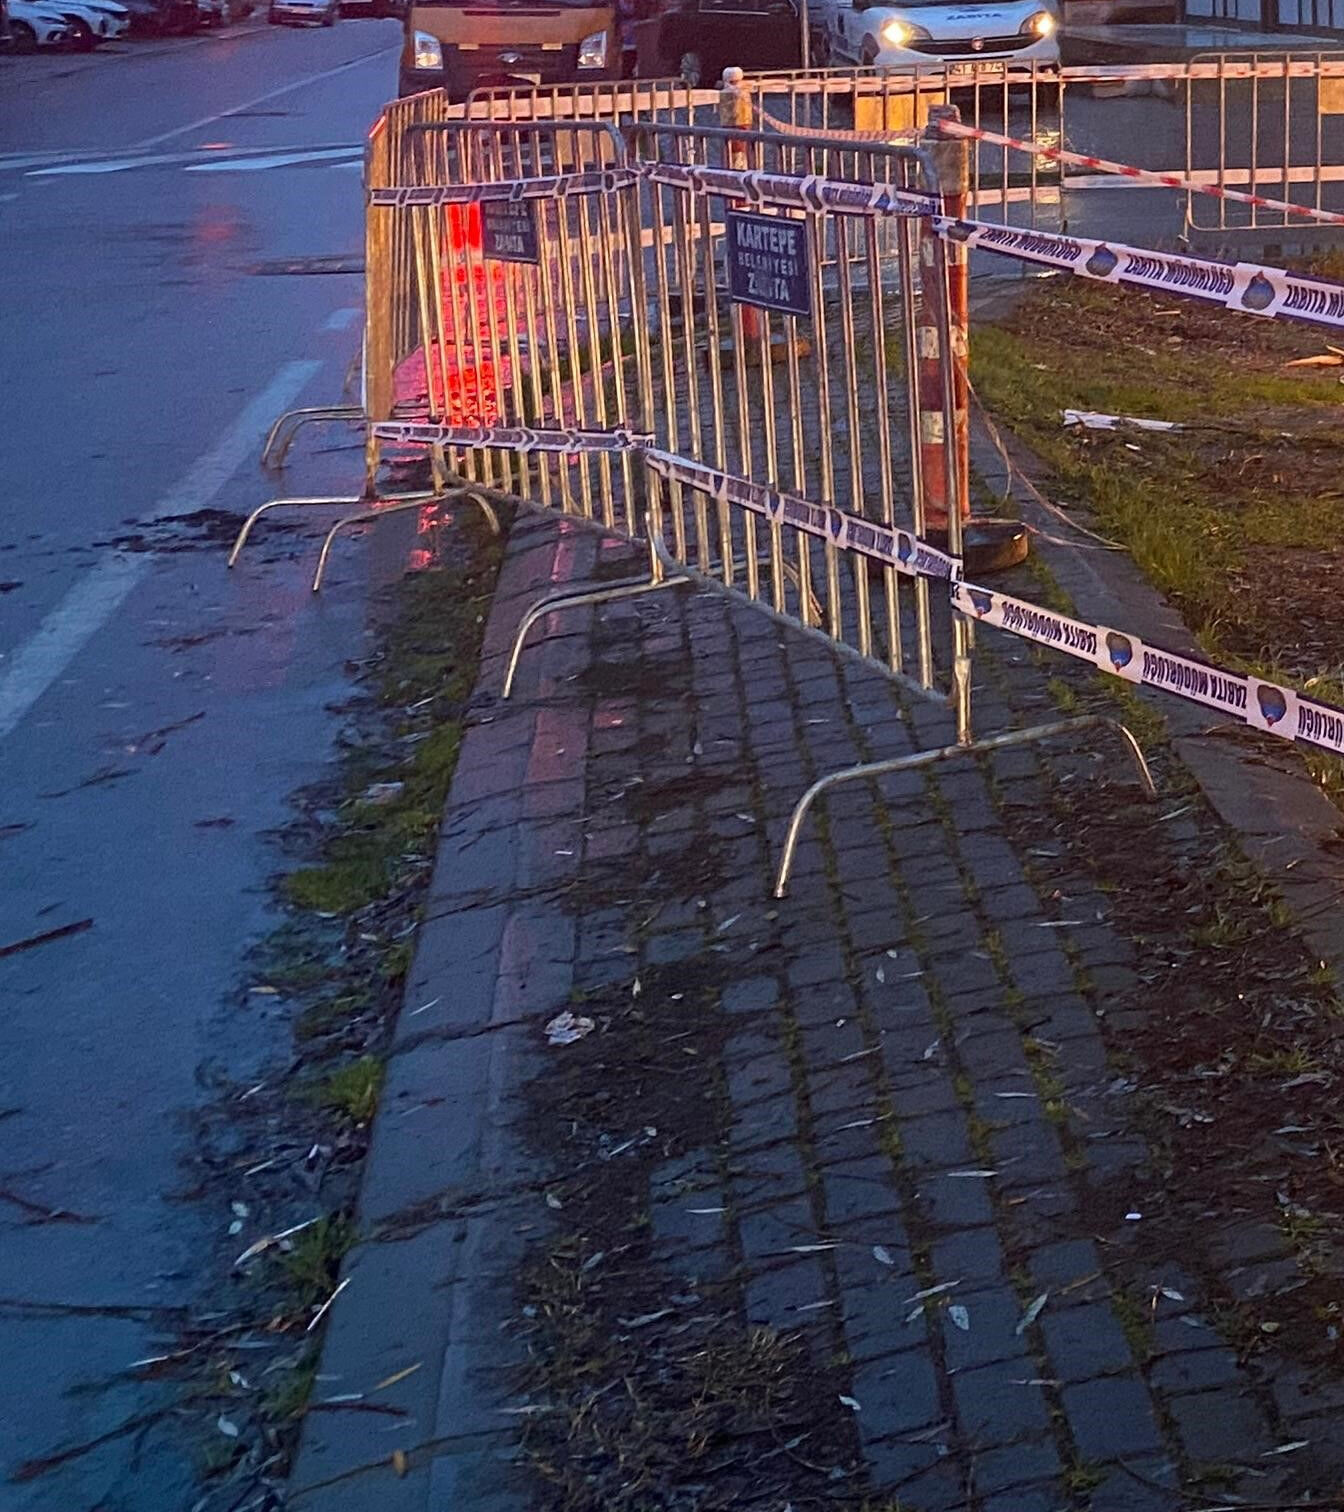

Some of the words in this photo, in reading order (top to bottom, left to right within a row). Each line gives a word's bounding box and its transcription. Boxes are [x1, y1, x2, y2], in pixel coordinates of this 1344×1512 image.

[736, 222, 797, 255] KARTEPE
[747, 272, 790, 301] ZITA
[1123, 253, 1163, 280] ZABITA
[1163, 260, 1235, 294] MÜDÜRLÜĞÜ
[1283, 284, 1326, 315] ZABITA
[1143, 650, 1209, 696] MÜDÜRLÜĞÜ
[1210, 673, 1247, 709] ZABITA
